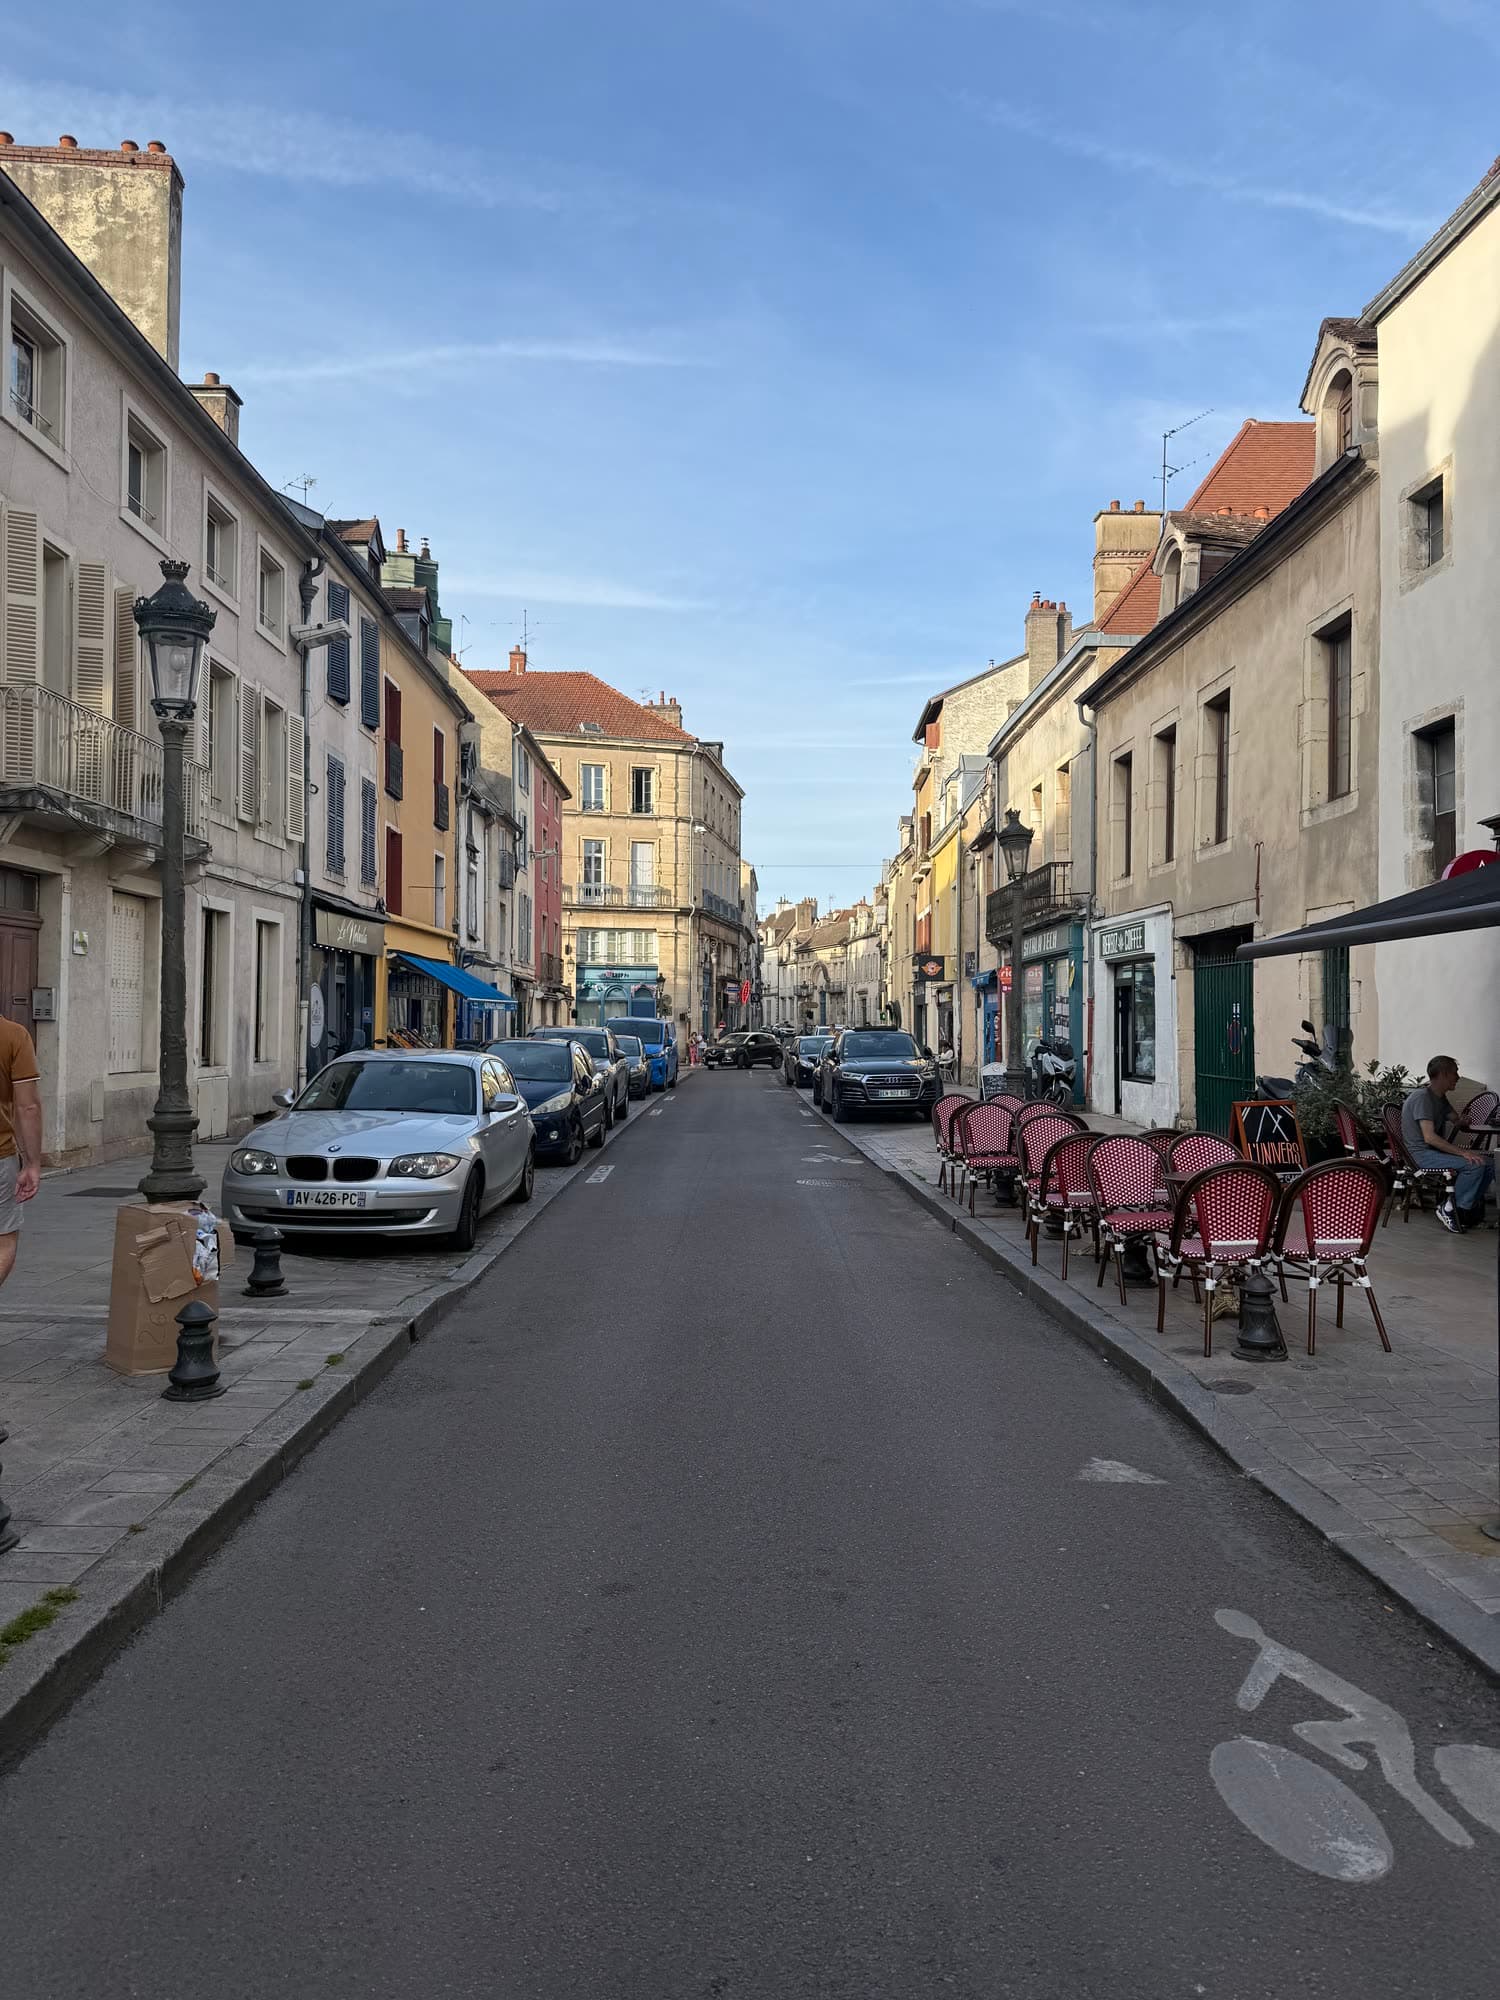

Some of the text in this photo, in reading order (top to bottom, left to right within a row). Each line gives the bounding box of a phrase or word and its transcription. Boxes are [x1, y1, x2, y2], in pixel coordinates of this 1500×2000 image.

[1042, 930, 1058, 951] TECH
[1124, 926, 1143, 951] COFFEE
[295, 1191, 357, 1205] AV-426-PC
